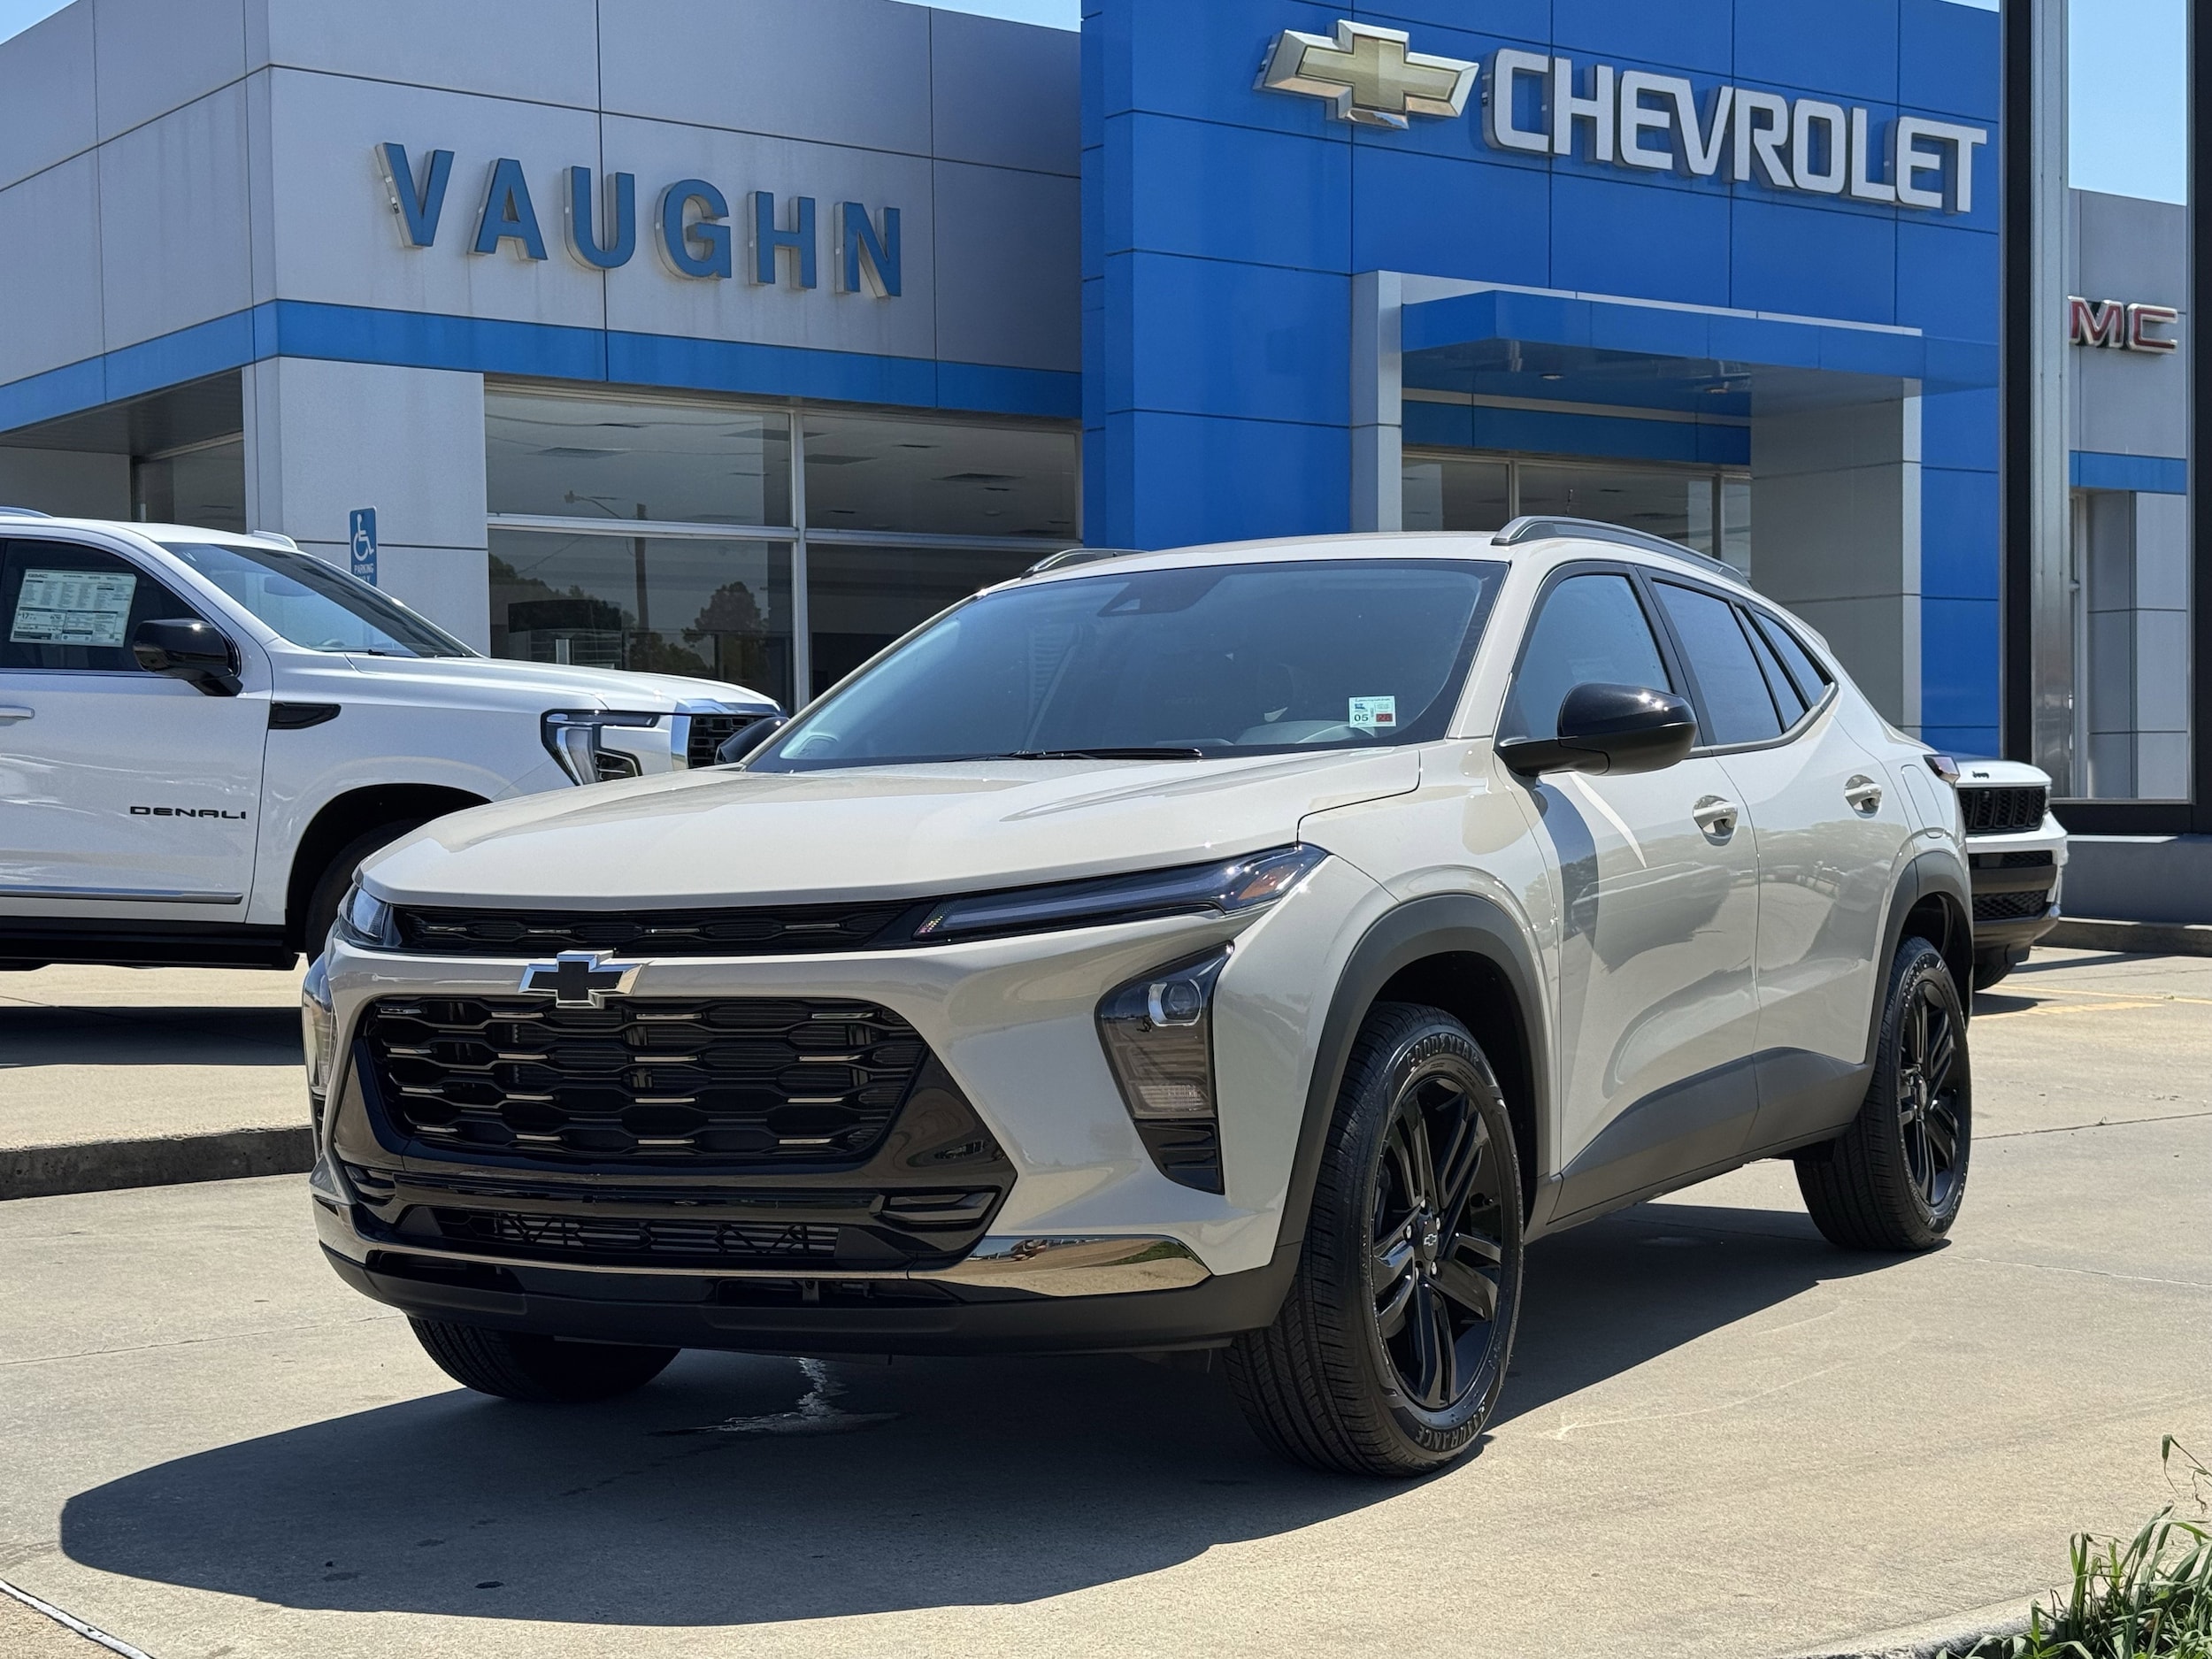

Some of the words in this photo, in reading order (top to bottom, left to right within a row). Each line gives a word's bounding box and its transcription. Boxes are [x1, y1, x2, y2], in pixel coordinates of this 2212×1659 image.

[1482, 47, 1987, 213] CHEVROLET
[376, 142, 901, 298] VAUGHN
[2067, 295, 2177, 354] MC
[130, 806, 246, 819] DENALI
[1406, 1033, 1479, 1072] GOODYEAR
